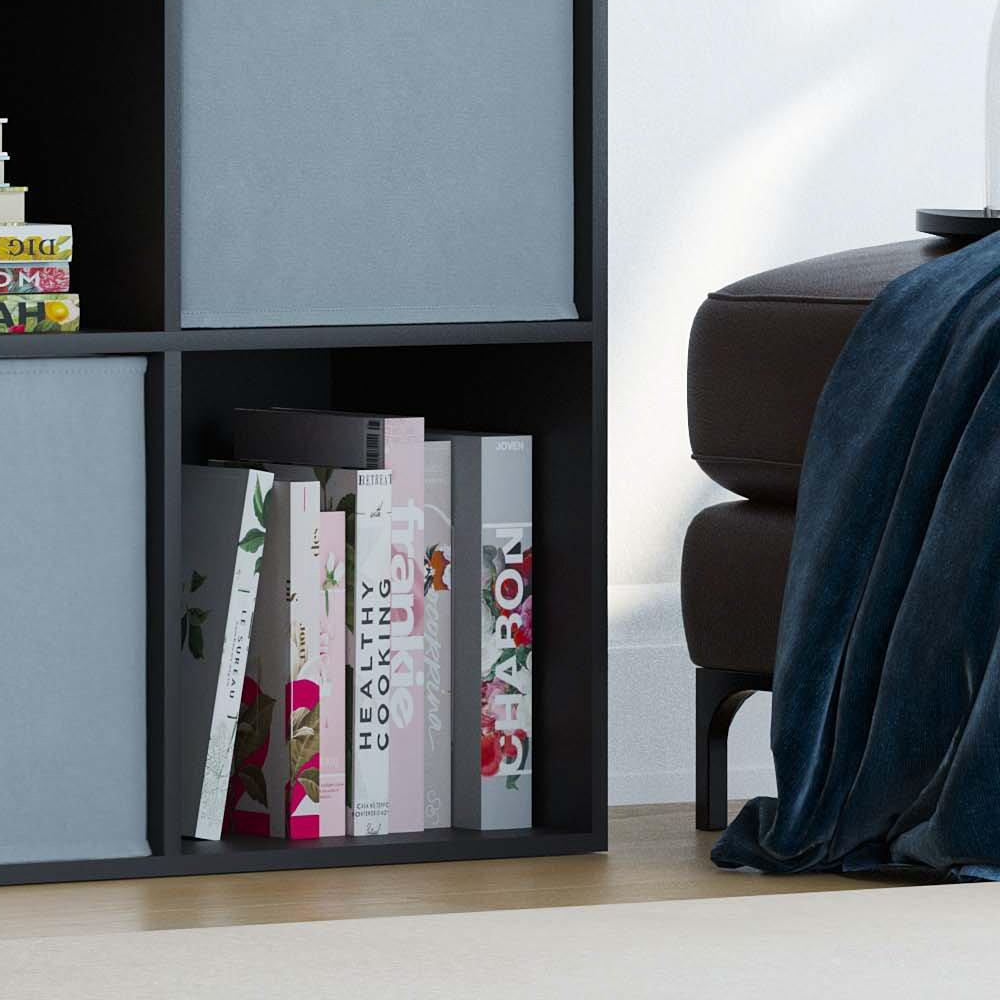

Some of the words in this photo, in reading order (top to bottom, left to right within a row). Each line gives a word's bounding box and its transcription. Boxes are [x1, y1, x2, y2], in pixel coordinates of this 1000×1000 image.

[9, 238, 56, 256] DIG
[229, 637, 243, 699] SUREAU
[359, 581, 375, 750] HEALTHY
[377, 577, 391, 752] COOKING
[391, 497, 424, 730] frankie
[494, 527, 525, 774] CHABON
